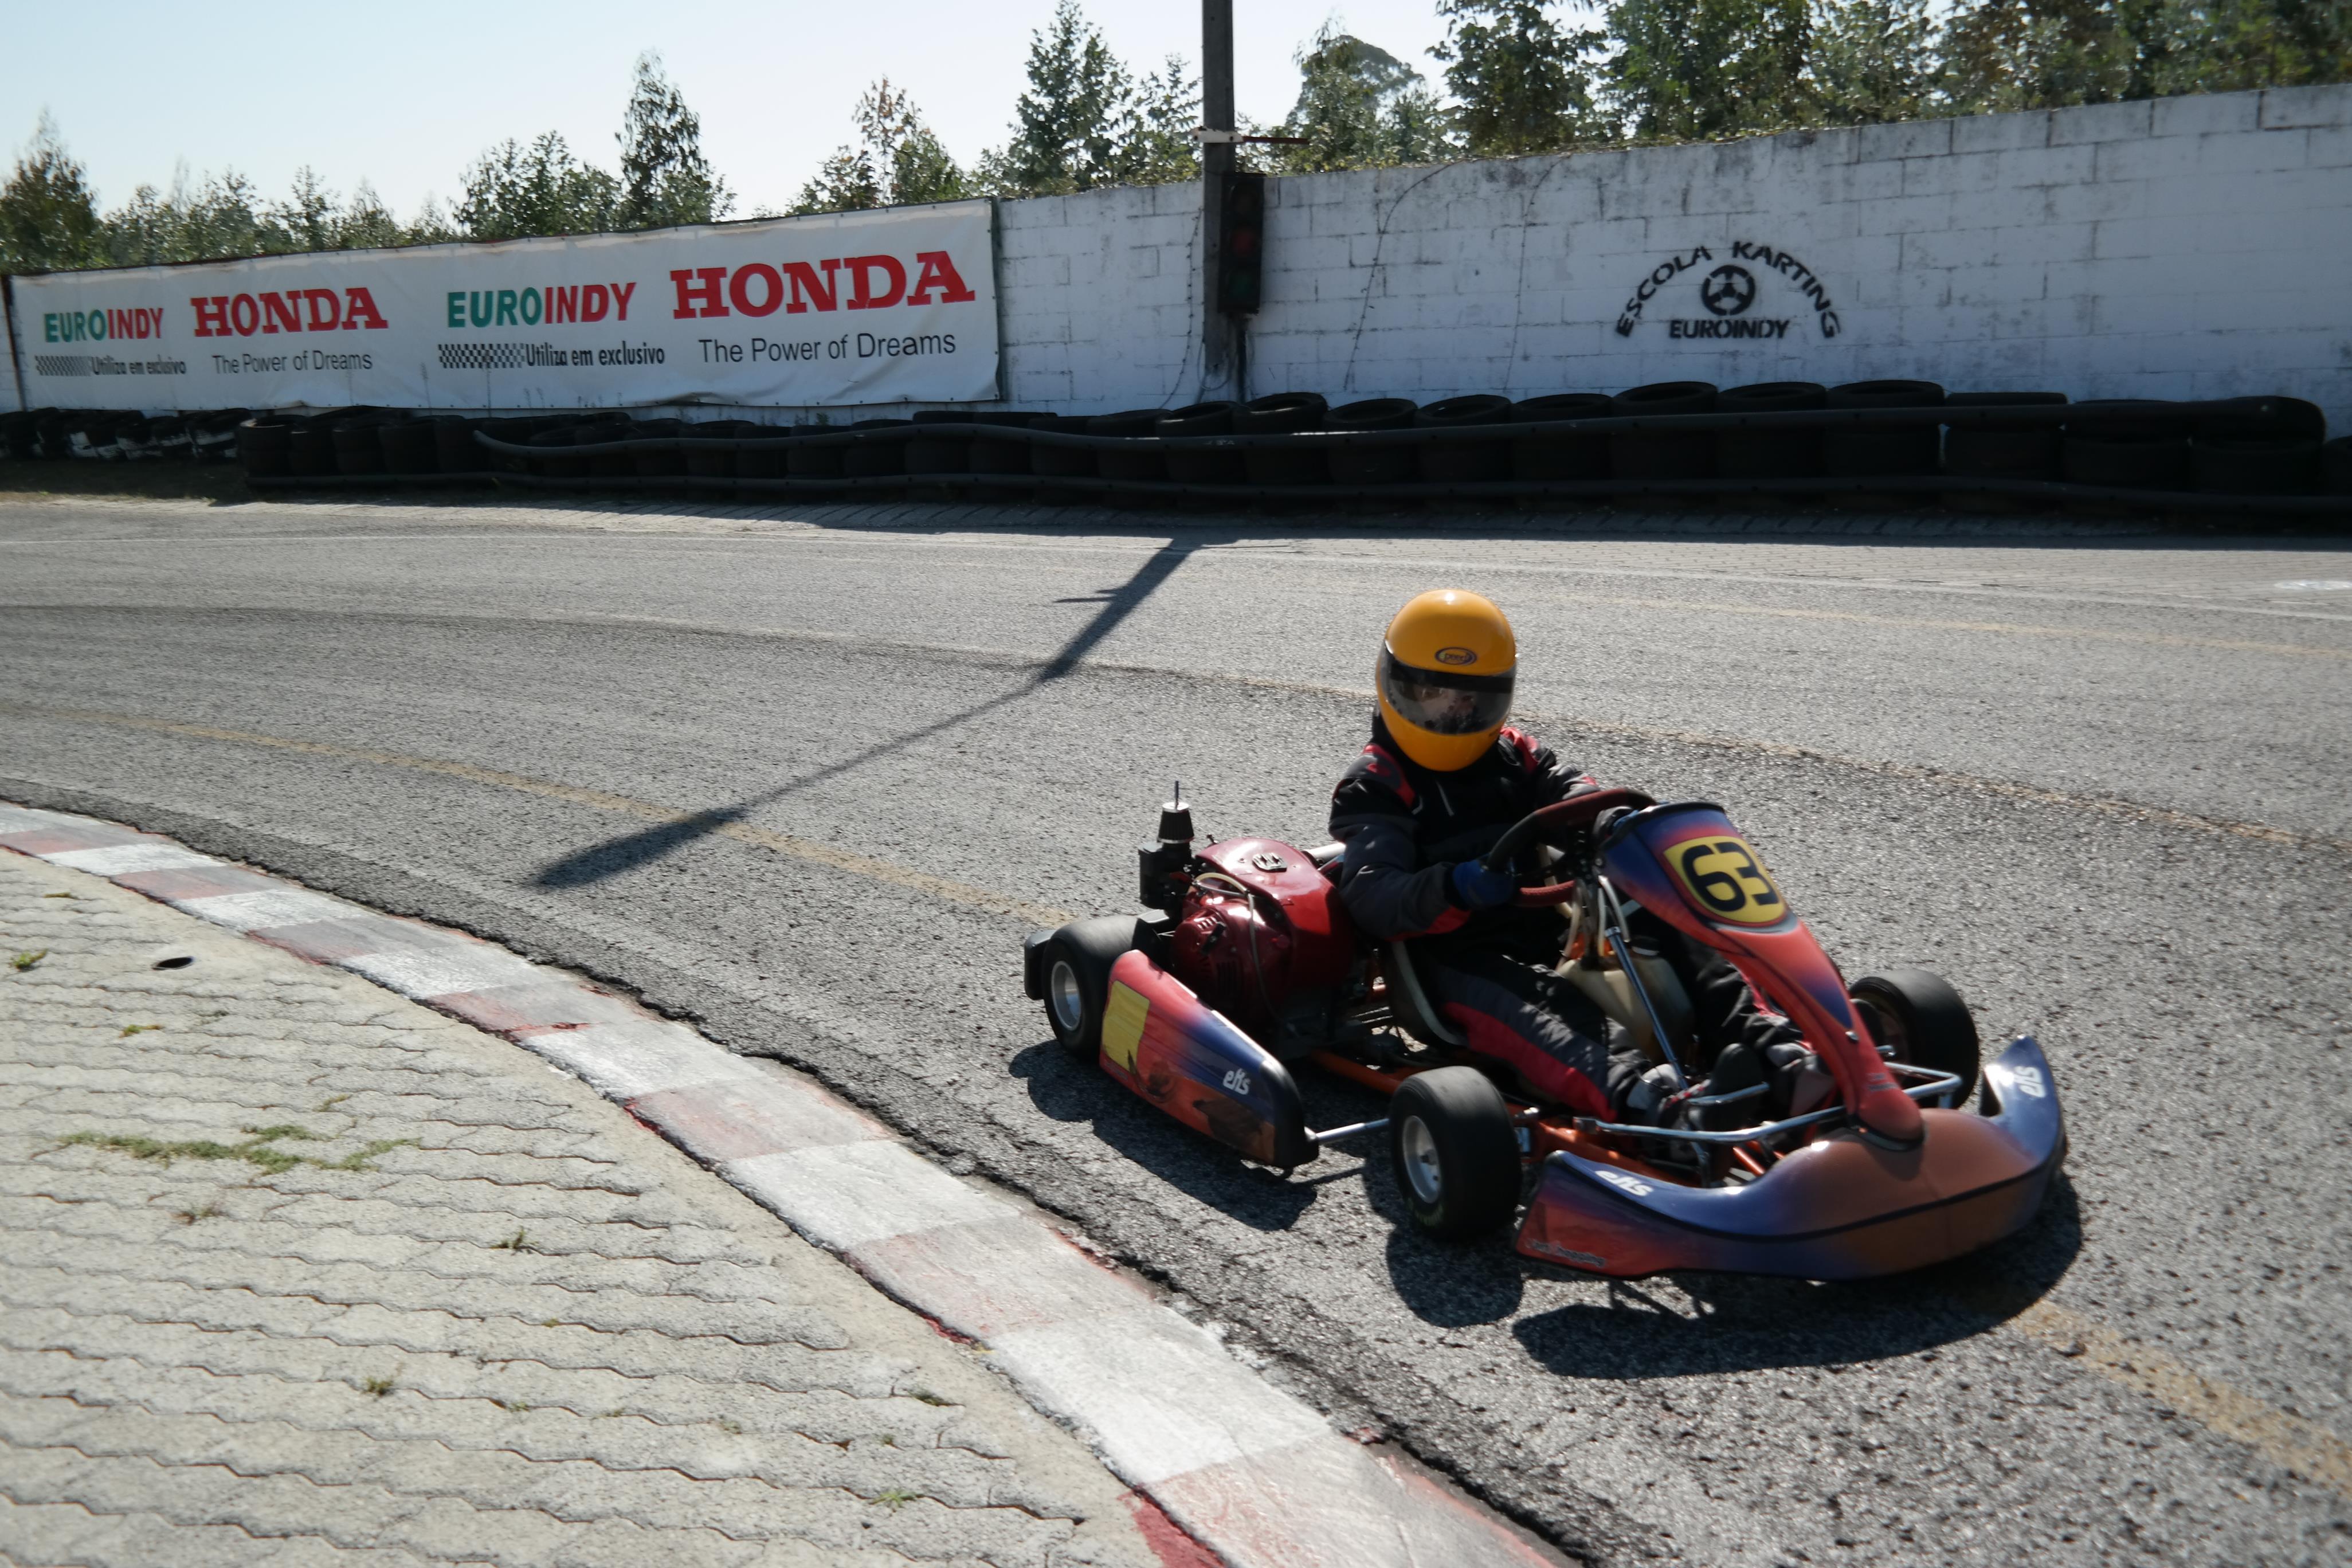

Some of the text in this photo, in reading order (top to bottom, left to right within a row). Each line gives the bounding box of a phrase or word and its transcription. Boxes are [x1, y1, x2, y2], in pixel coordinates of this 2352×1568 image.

[447, 282, 637, 328] EUROINDY
[670, 250, 975, 320] HONDA
[1615, 241, 1842, 339] ESCOLA KARTING
[44, 308, 163, 343] EUROINDY
[190, 287, 389, 338] HONDA
[1669, 319, 1789, 339] EUROINDY
[211, 349, 373, 374] The Power of Dreams
[526, 340, 666, 367] Utiliza em exclusivo
[698, 333, 956, 363] The Power of Dreams
[1681, 841, 1779, 912] 63
